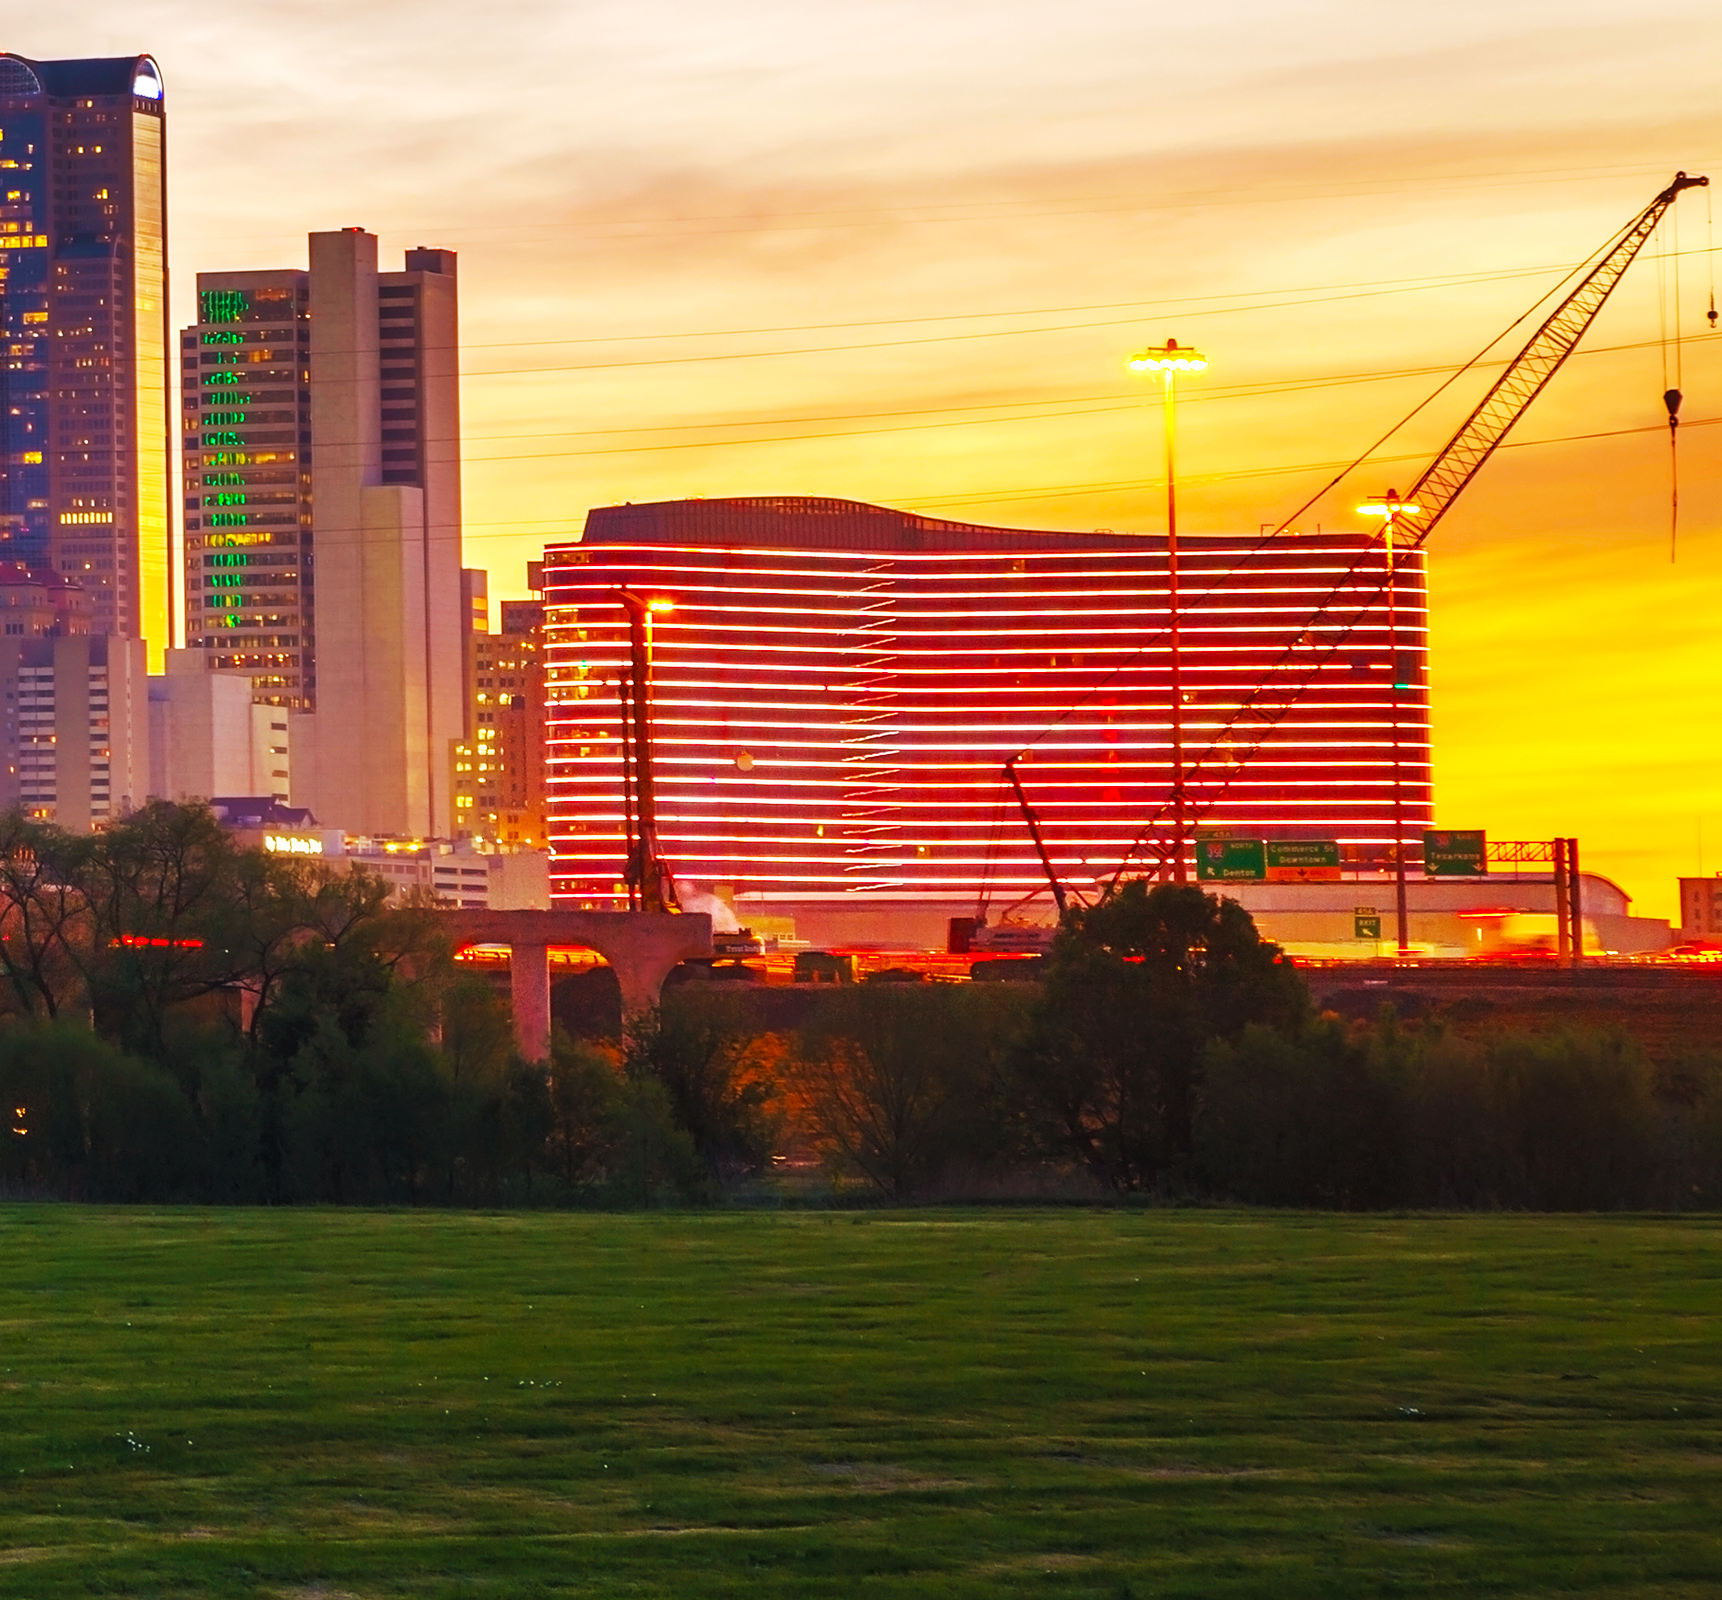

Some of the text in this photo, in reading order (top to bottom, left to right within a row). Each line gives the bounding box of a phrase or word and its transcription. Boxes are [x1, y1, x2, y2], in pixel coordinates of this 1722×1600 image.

[1270, 844, 1335, 853] Commerce St
[1279, 855, 1327, 864] Downtown
[1223, 868, 1256, 877] Denton
